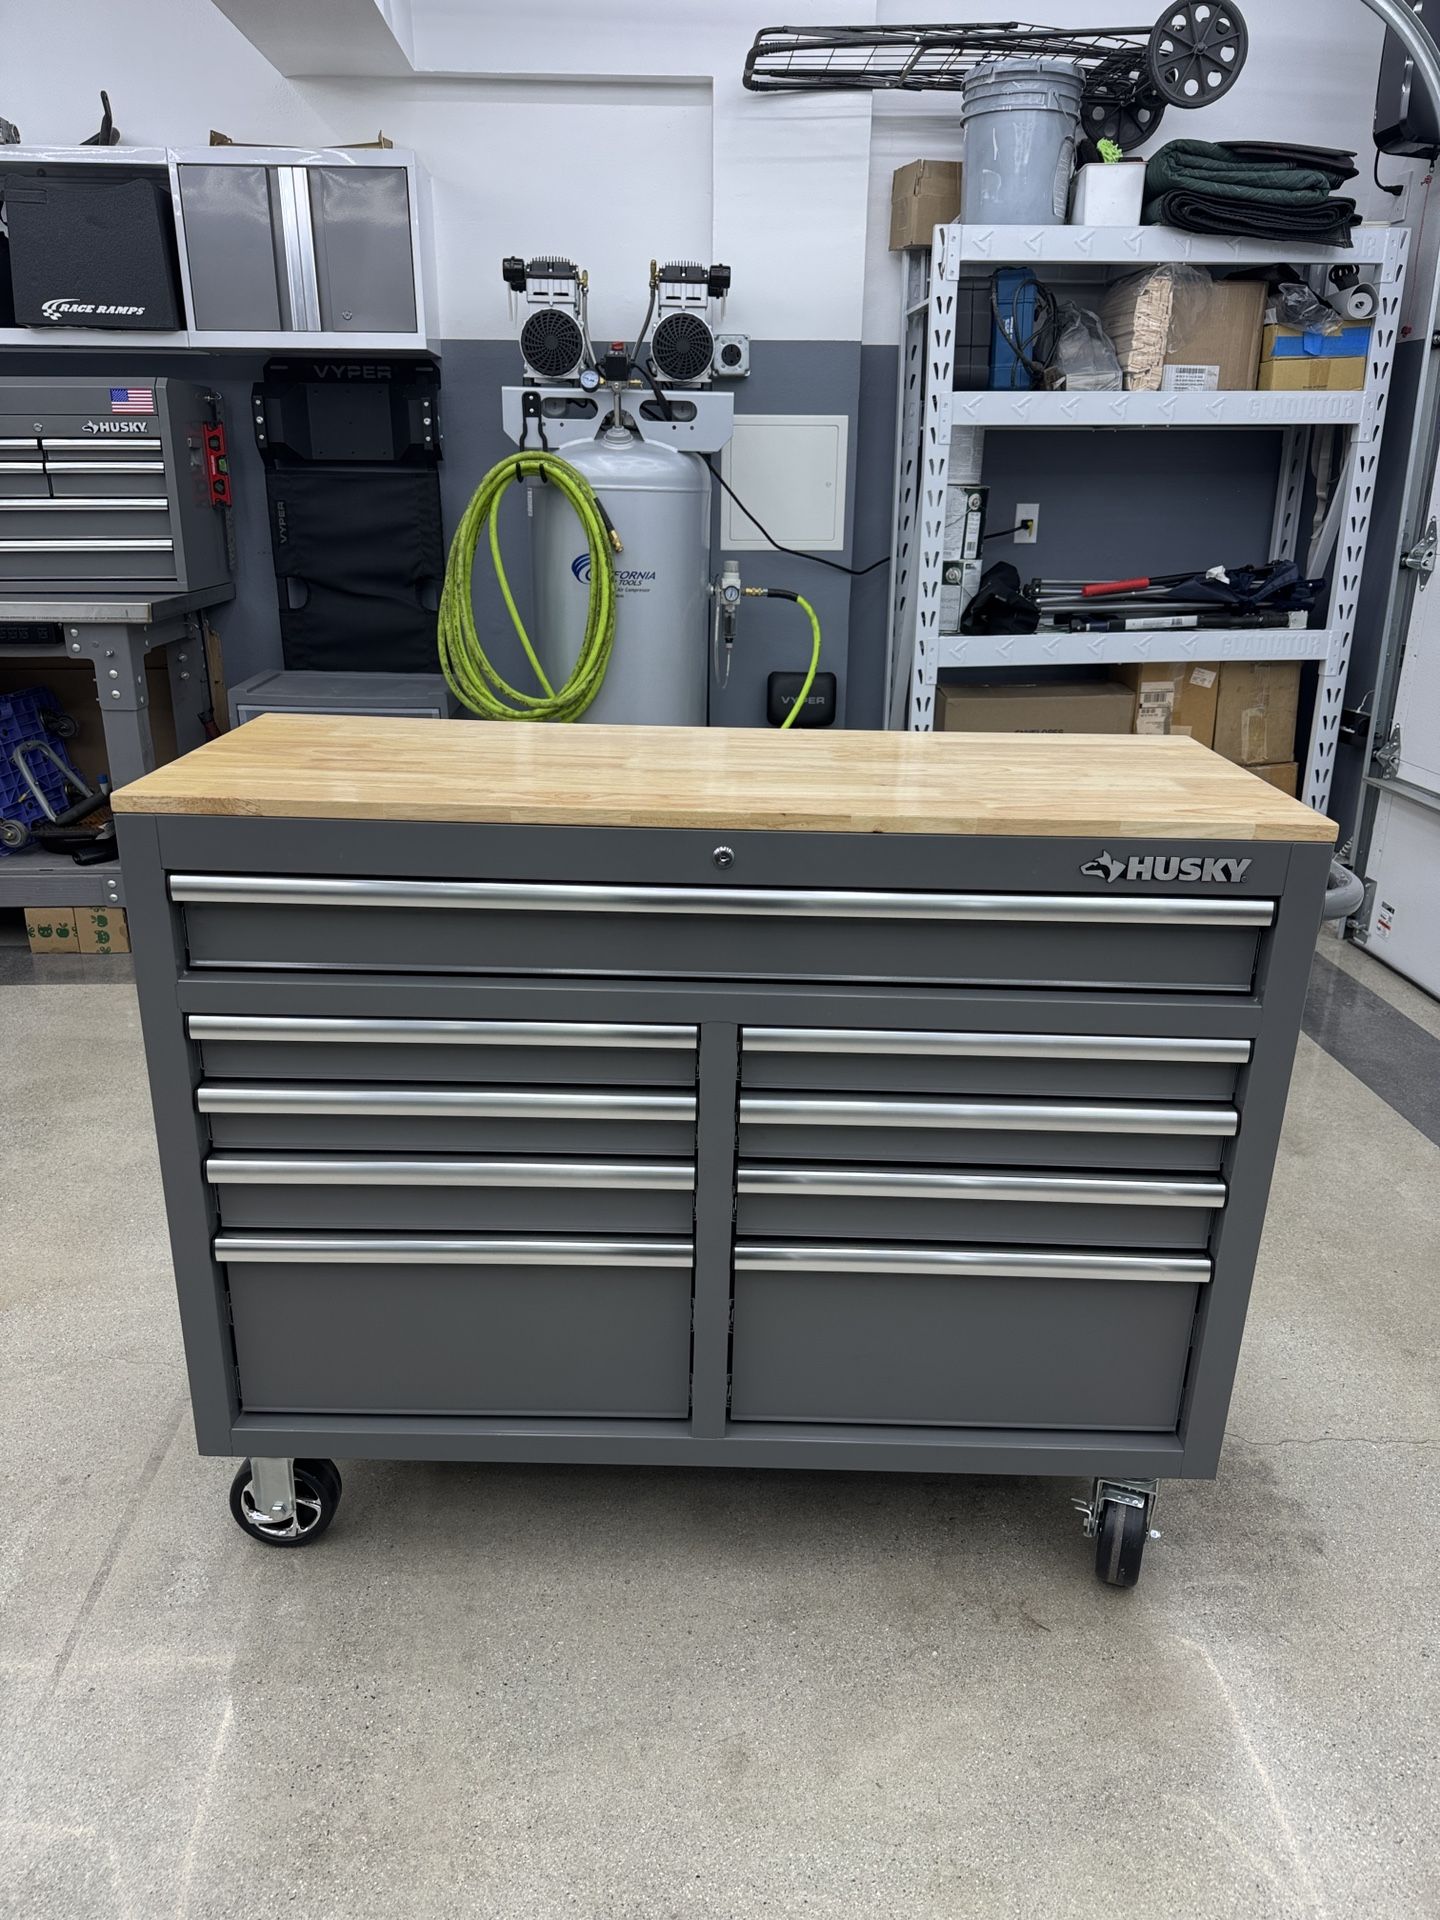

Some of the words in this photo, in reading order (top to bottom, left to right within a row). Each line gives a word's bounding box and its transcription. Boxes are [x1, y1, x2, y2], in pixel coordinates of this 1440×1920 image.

[59, 303, 95, 313] RACE
[96, 305, 146, 316] RAMPS
[313, 364, 392, 379] VYPER
[1248, 395, 1354, 419] GLADIATOR
[99, 421, 147, 433] HUSKY
[277, 501, 288, 544] VYPER
[1221, 633, 1322, 657] GLADIATOR
[781, 696, 825, 705] VYER
[1126, 856, 1252, 883] HUSKY
